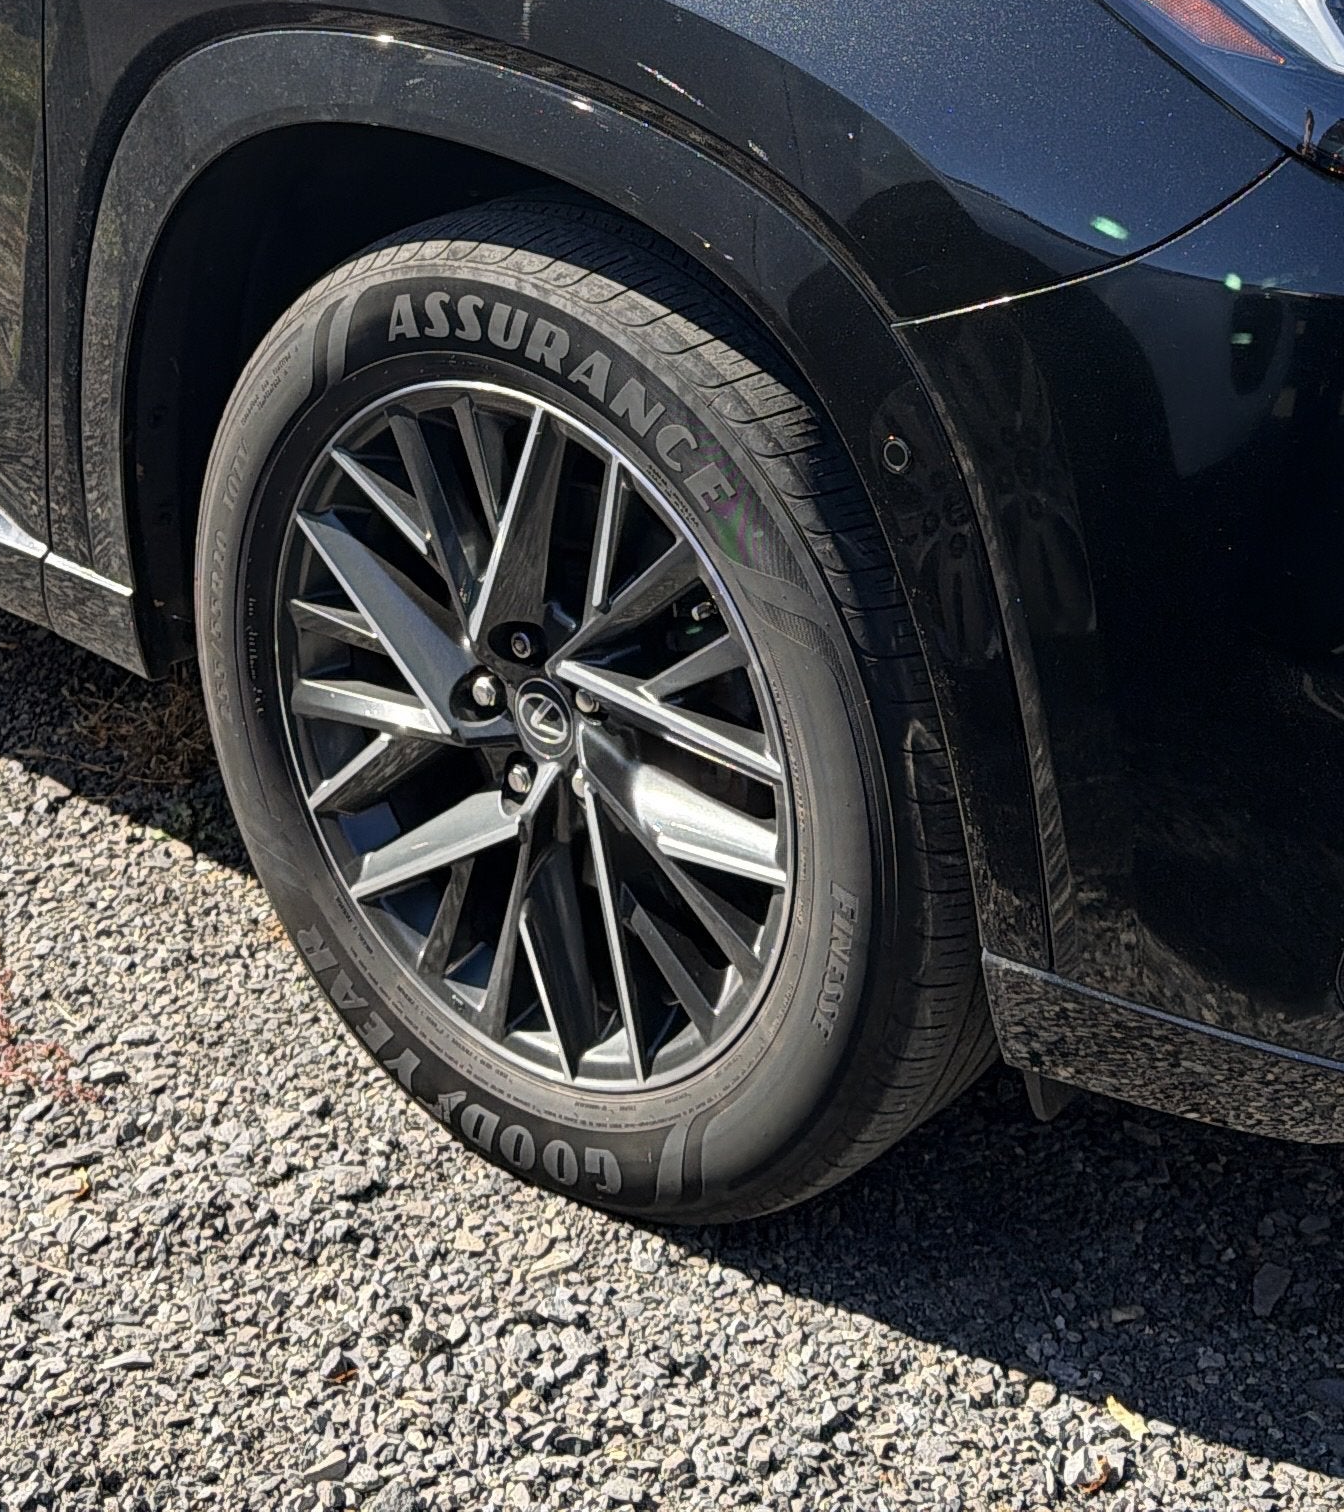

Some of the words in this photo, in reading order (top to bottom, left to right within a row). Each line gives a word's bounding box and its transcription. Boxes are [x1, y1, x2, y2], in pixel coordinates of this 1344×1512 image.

[388, 291, 737, 513] ASSURANCE
[297, 924, 623, 1195] GOODYEAR
[811, 880, 859, 1040] FINESSE
